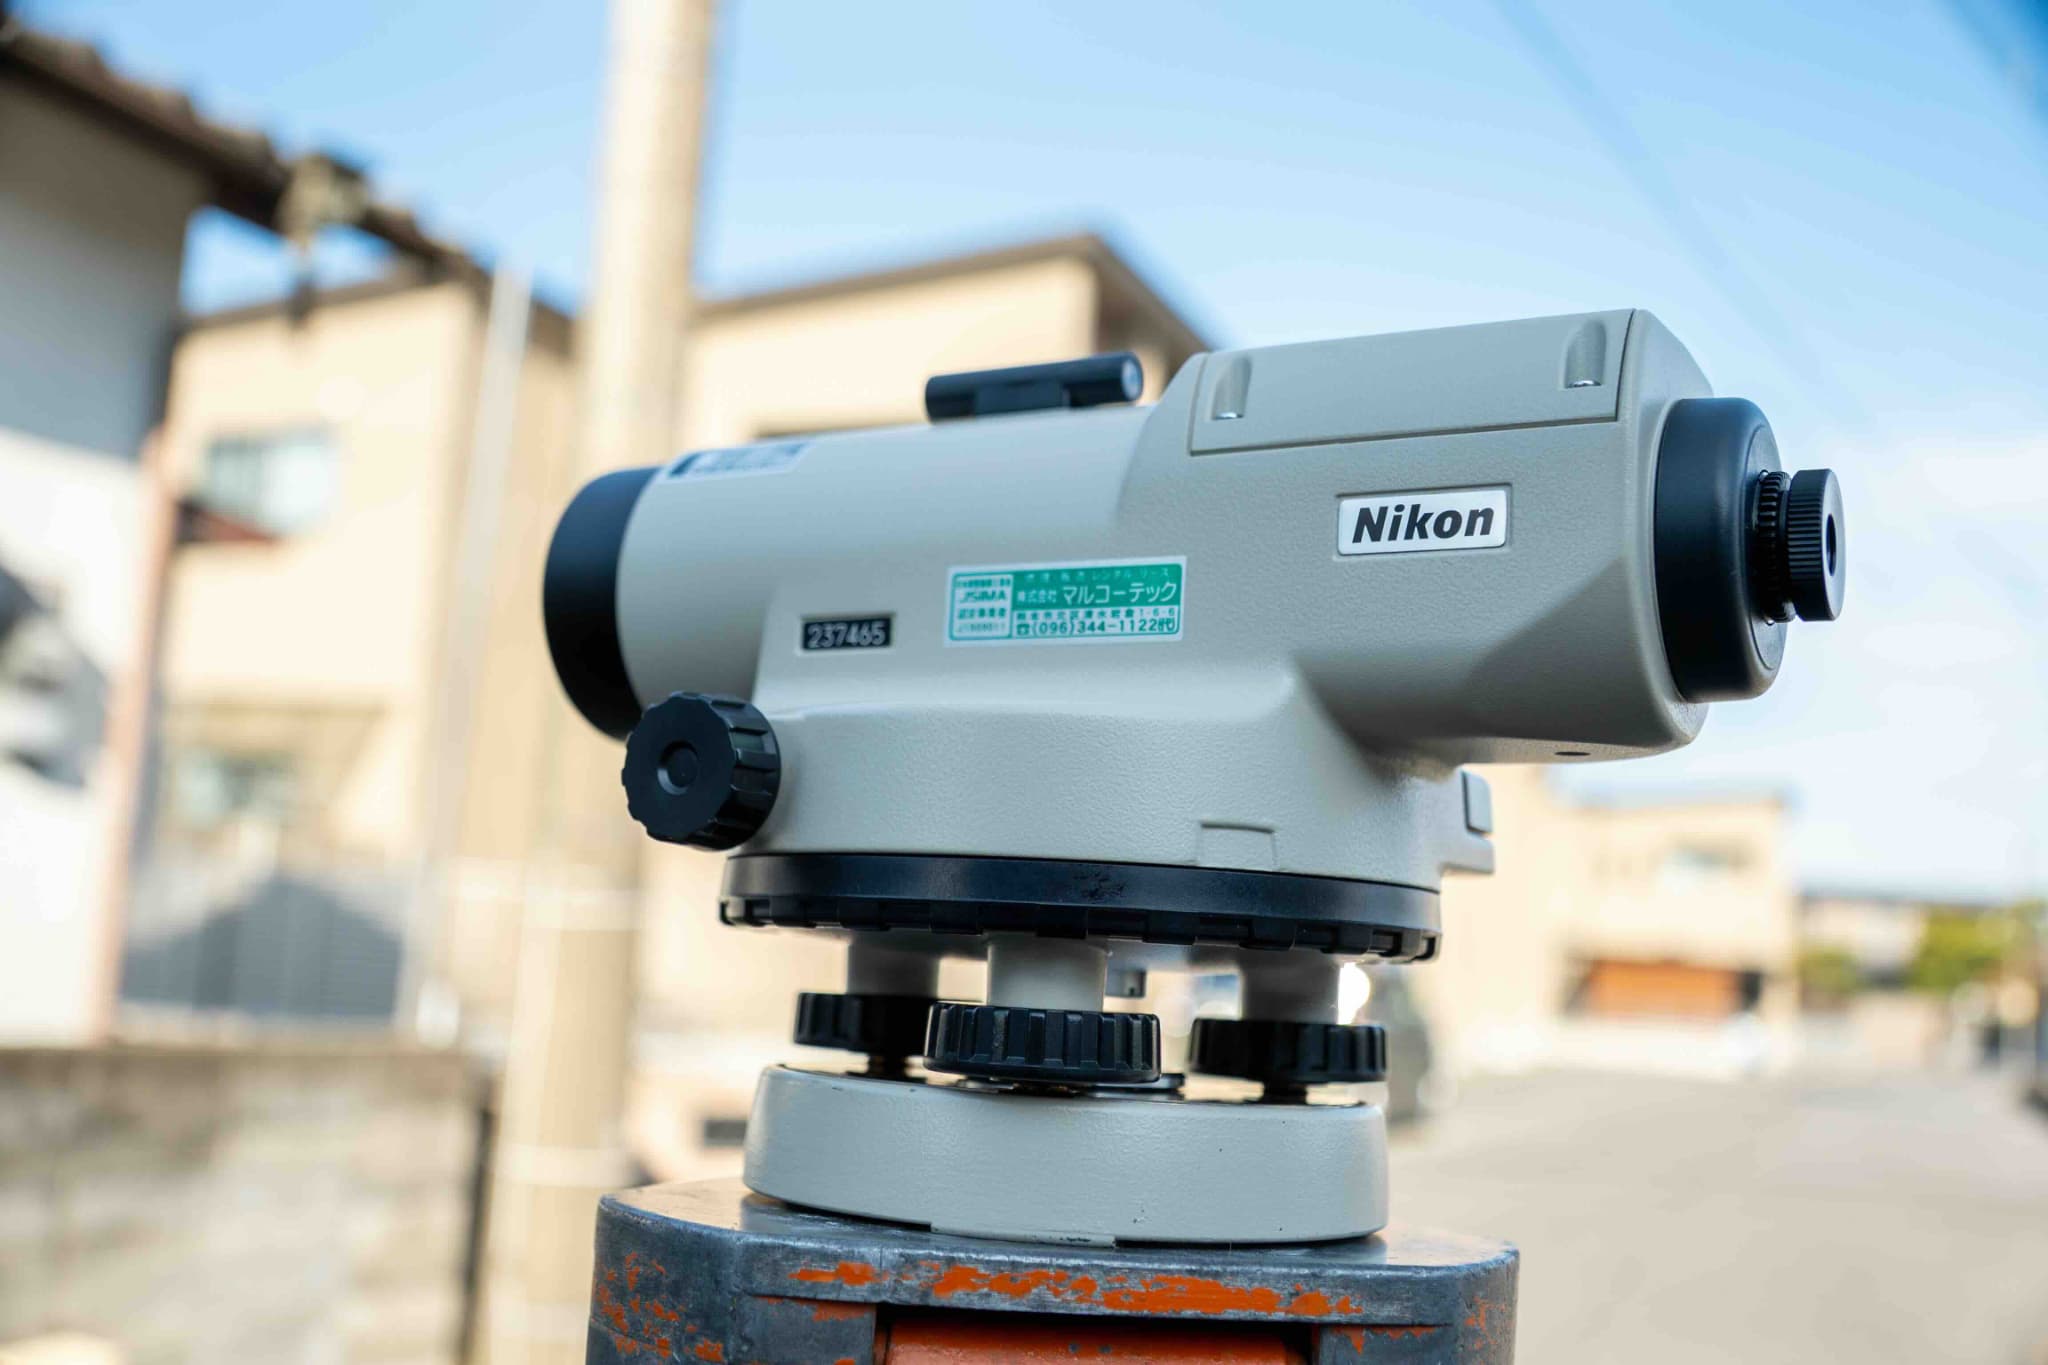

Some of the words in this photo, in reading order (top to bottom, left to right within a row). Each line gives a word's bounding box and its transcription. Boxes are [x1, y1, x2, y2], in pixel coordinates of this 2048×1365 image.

[1351, 503, 1495, 544] Nikon
[1062, 581, 1177, 605] マルコーテック
[807, 620, 886, 648] 237465
